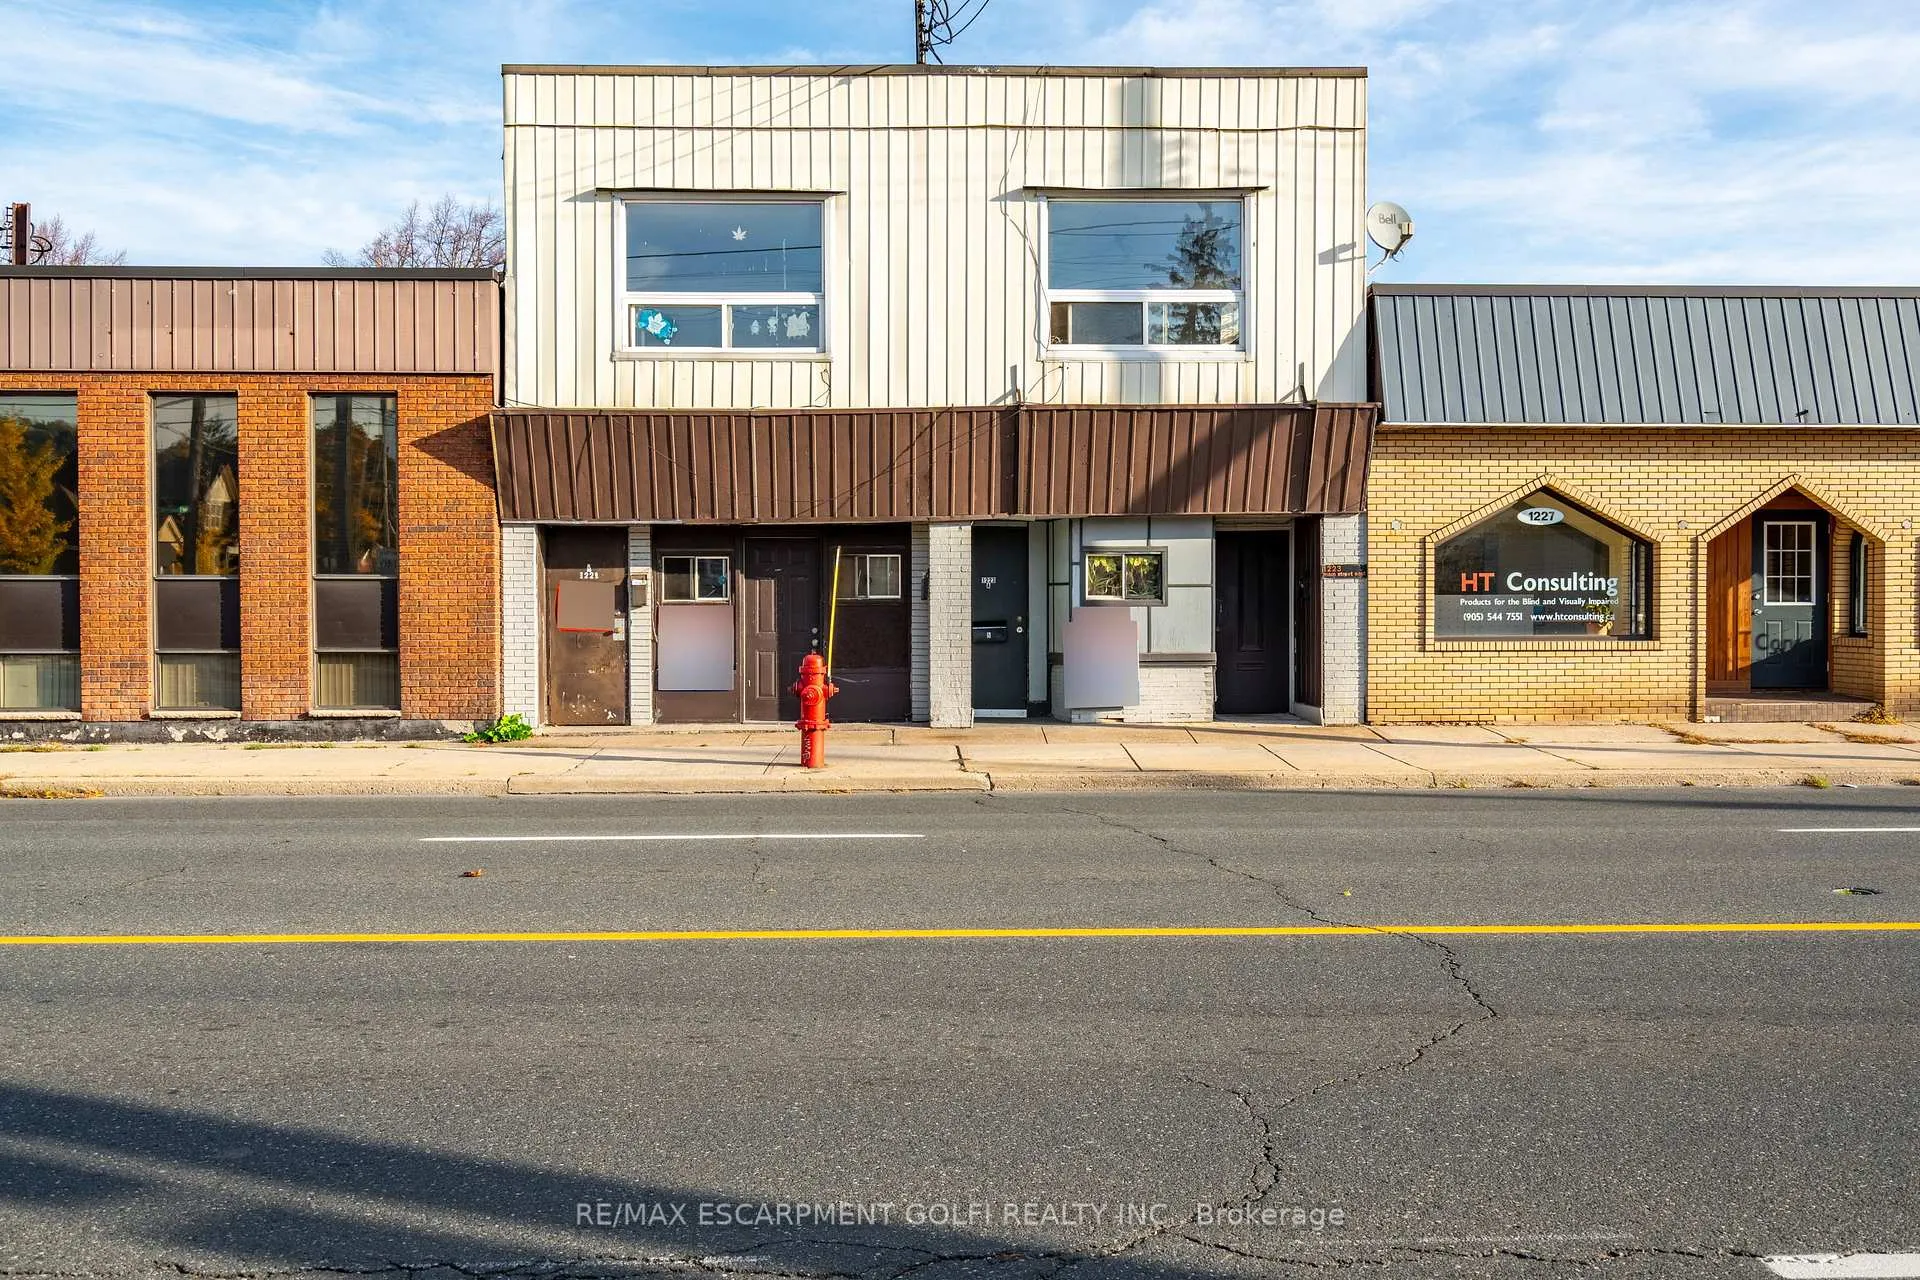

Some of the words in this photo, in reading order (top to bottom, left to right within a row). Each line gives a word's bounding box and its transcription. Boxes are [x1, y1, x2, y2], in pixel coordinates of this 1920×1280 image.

[1378, 213, 1397, 224] Bell
[1528, 511, 1555, 521] 1227
[1461, 572, 1495, 592] HT
[1506, 572, 1618, 597] Consulting
[1460, 598, 1491, 606] Products
[1494, 598, 1505, 606] for
[1507, 598, 1520, 606] the
[1522, 598, 1540, 606] Blind
[1542, 598, 1556, 606] and
[1559, 598, 1586, 607] Visually
[1588, 598, 1619, 607] Impaired
[1463, 612, 1484, 621] (905)
[1487, 612, 1503, 621] 544
[1506, 612, 1523, 621] 7551
[1530, 612, 1615, 623] www.htconsulting.ca
